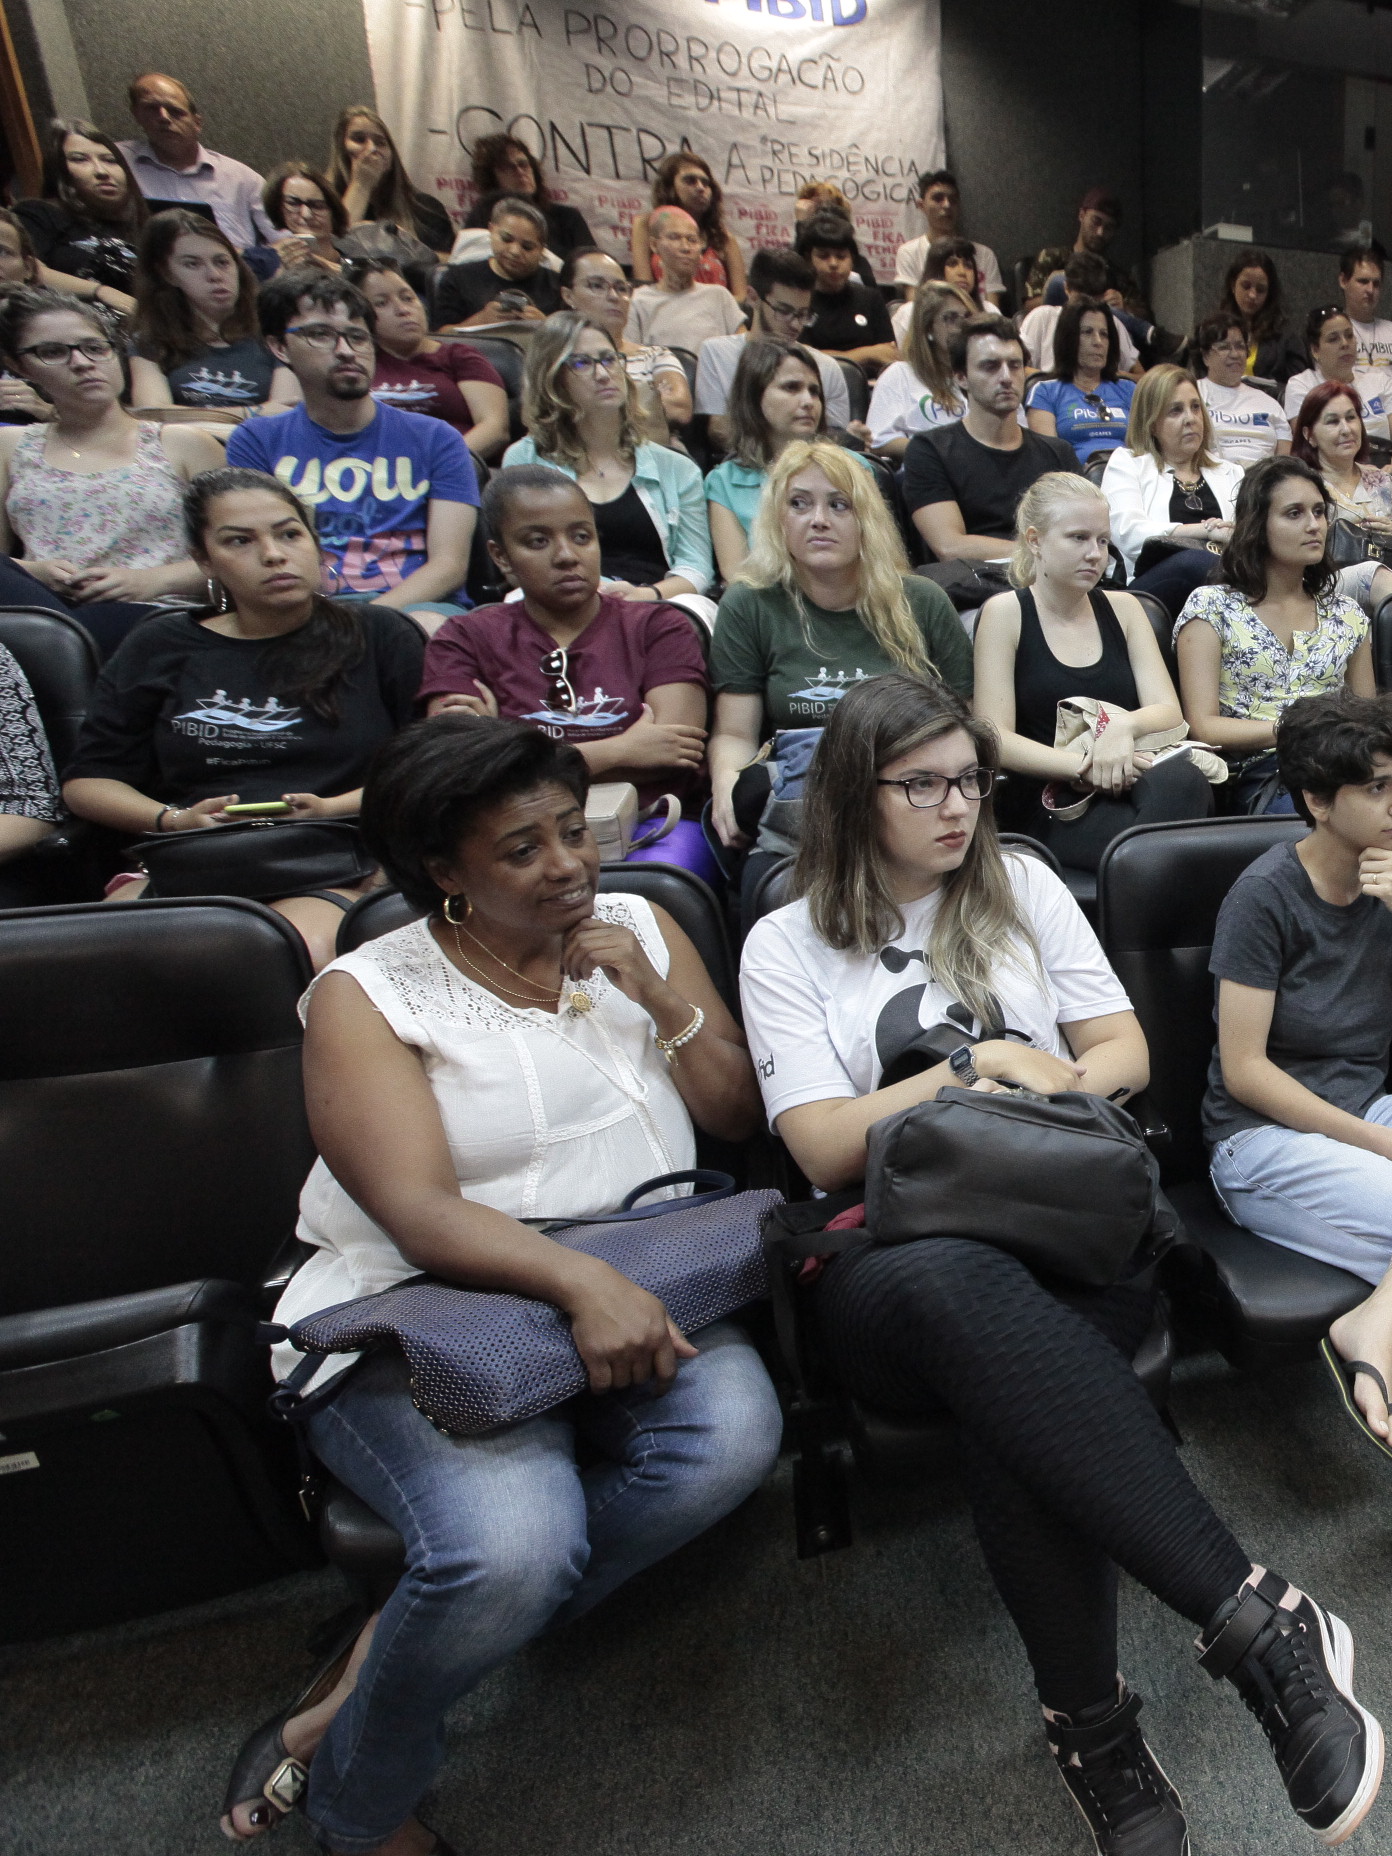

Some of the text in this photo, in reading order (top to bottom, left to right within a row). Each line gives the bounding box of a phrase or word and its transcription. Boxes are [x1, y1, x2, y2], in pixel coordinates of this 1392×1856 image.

[585, 62, 797, 124] DO EDITAL
[724, 142, 752, 186] A
[274, 455, 431, 505] you
[171, 719, 219, 739] PIBID
[789, 701, 826, 715] PIBID
